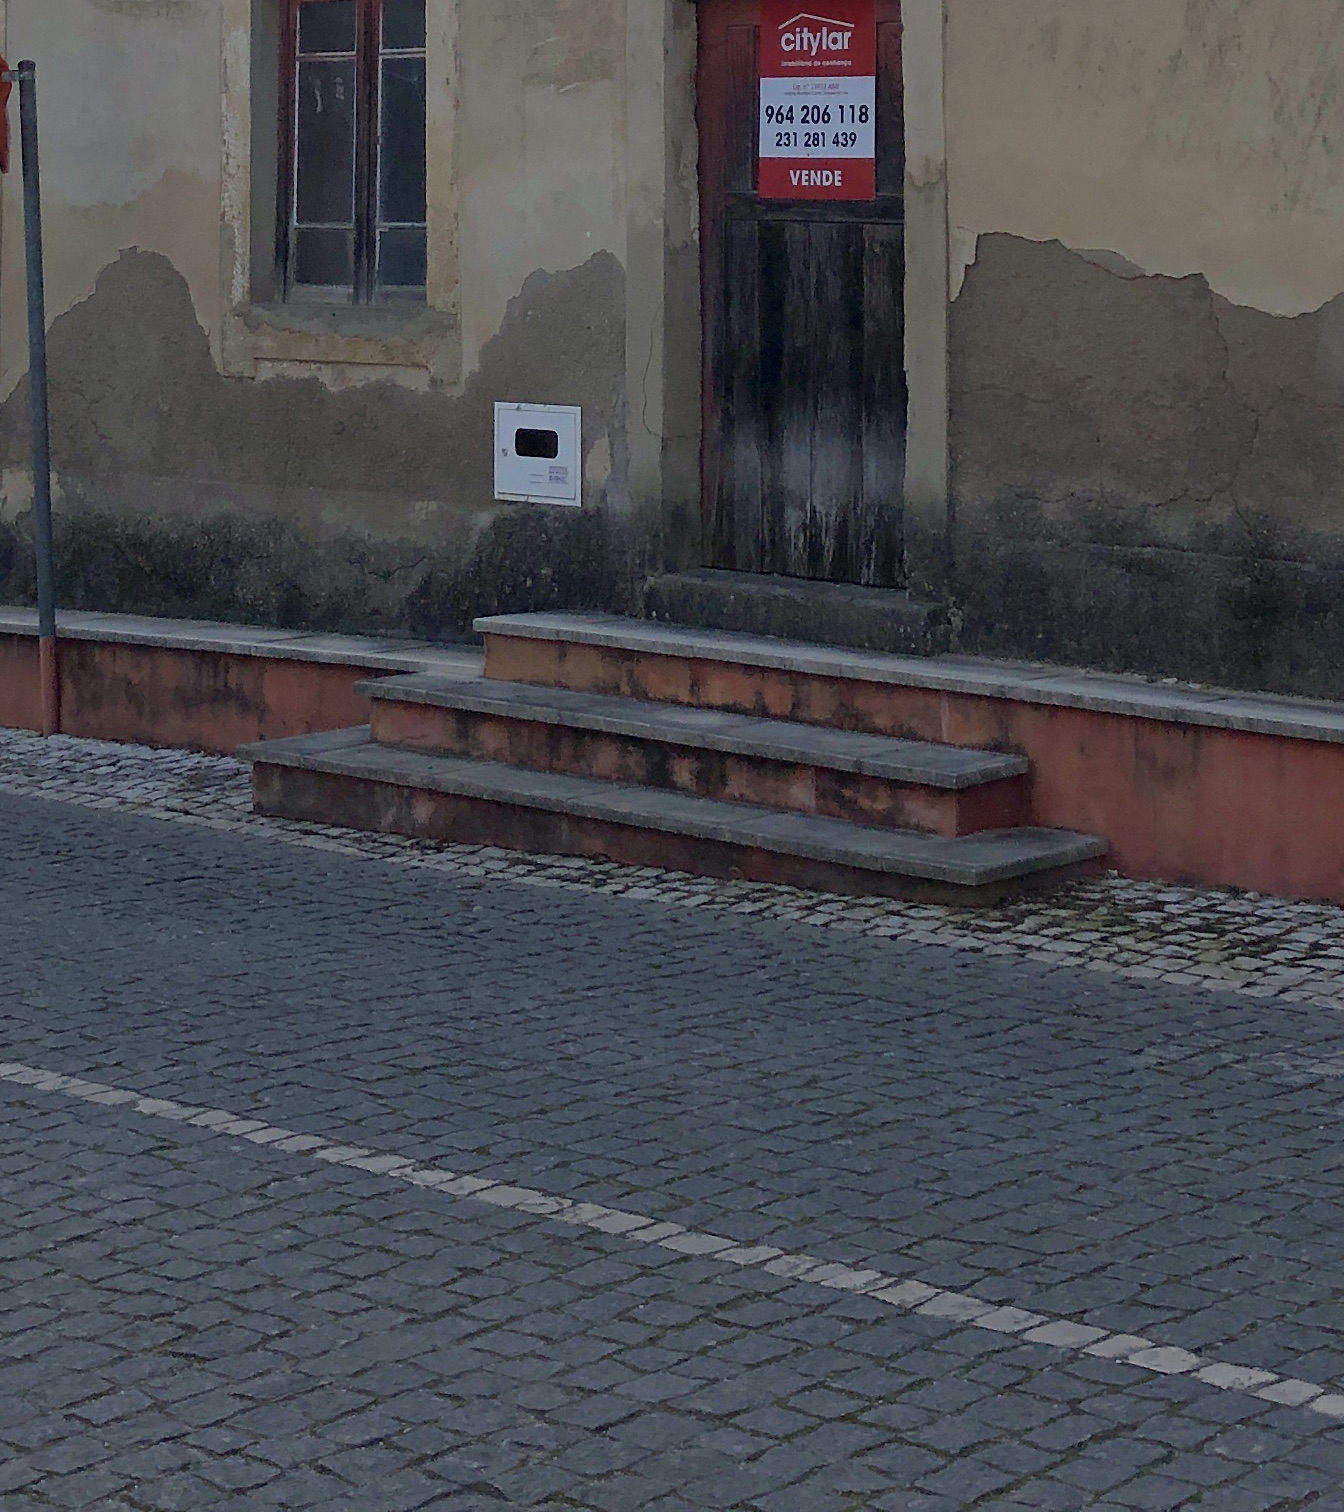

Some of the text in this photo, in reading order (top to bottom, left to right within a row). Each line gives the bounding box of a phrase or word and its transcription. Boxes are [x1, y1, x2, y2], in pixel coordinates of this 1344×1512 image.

[780, 27, 852, 57] citylar
[765, 105, 869, 124] 964 206 118
[775, 132, 857, 147] 231 281 439
[789, 170, 842, 186] VENDE
